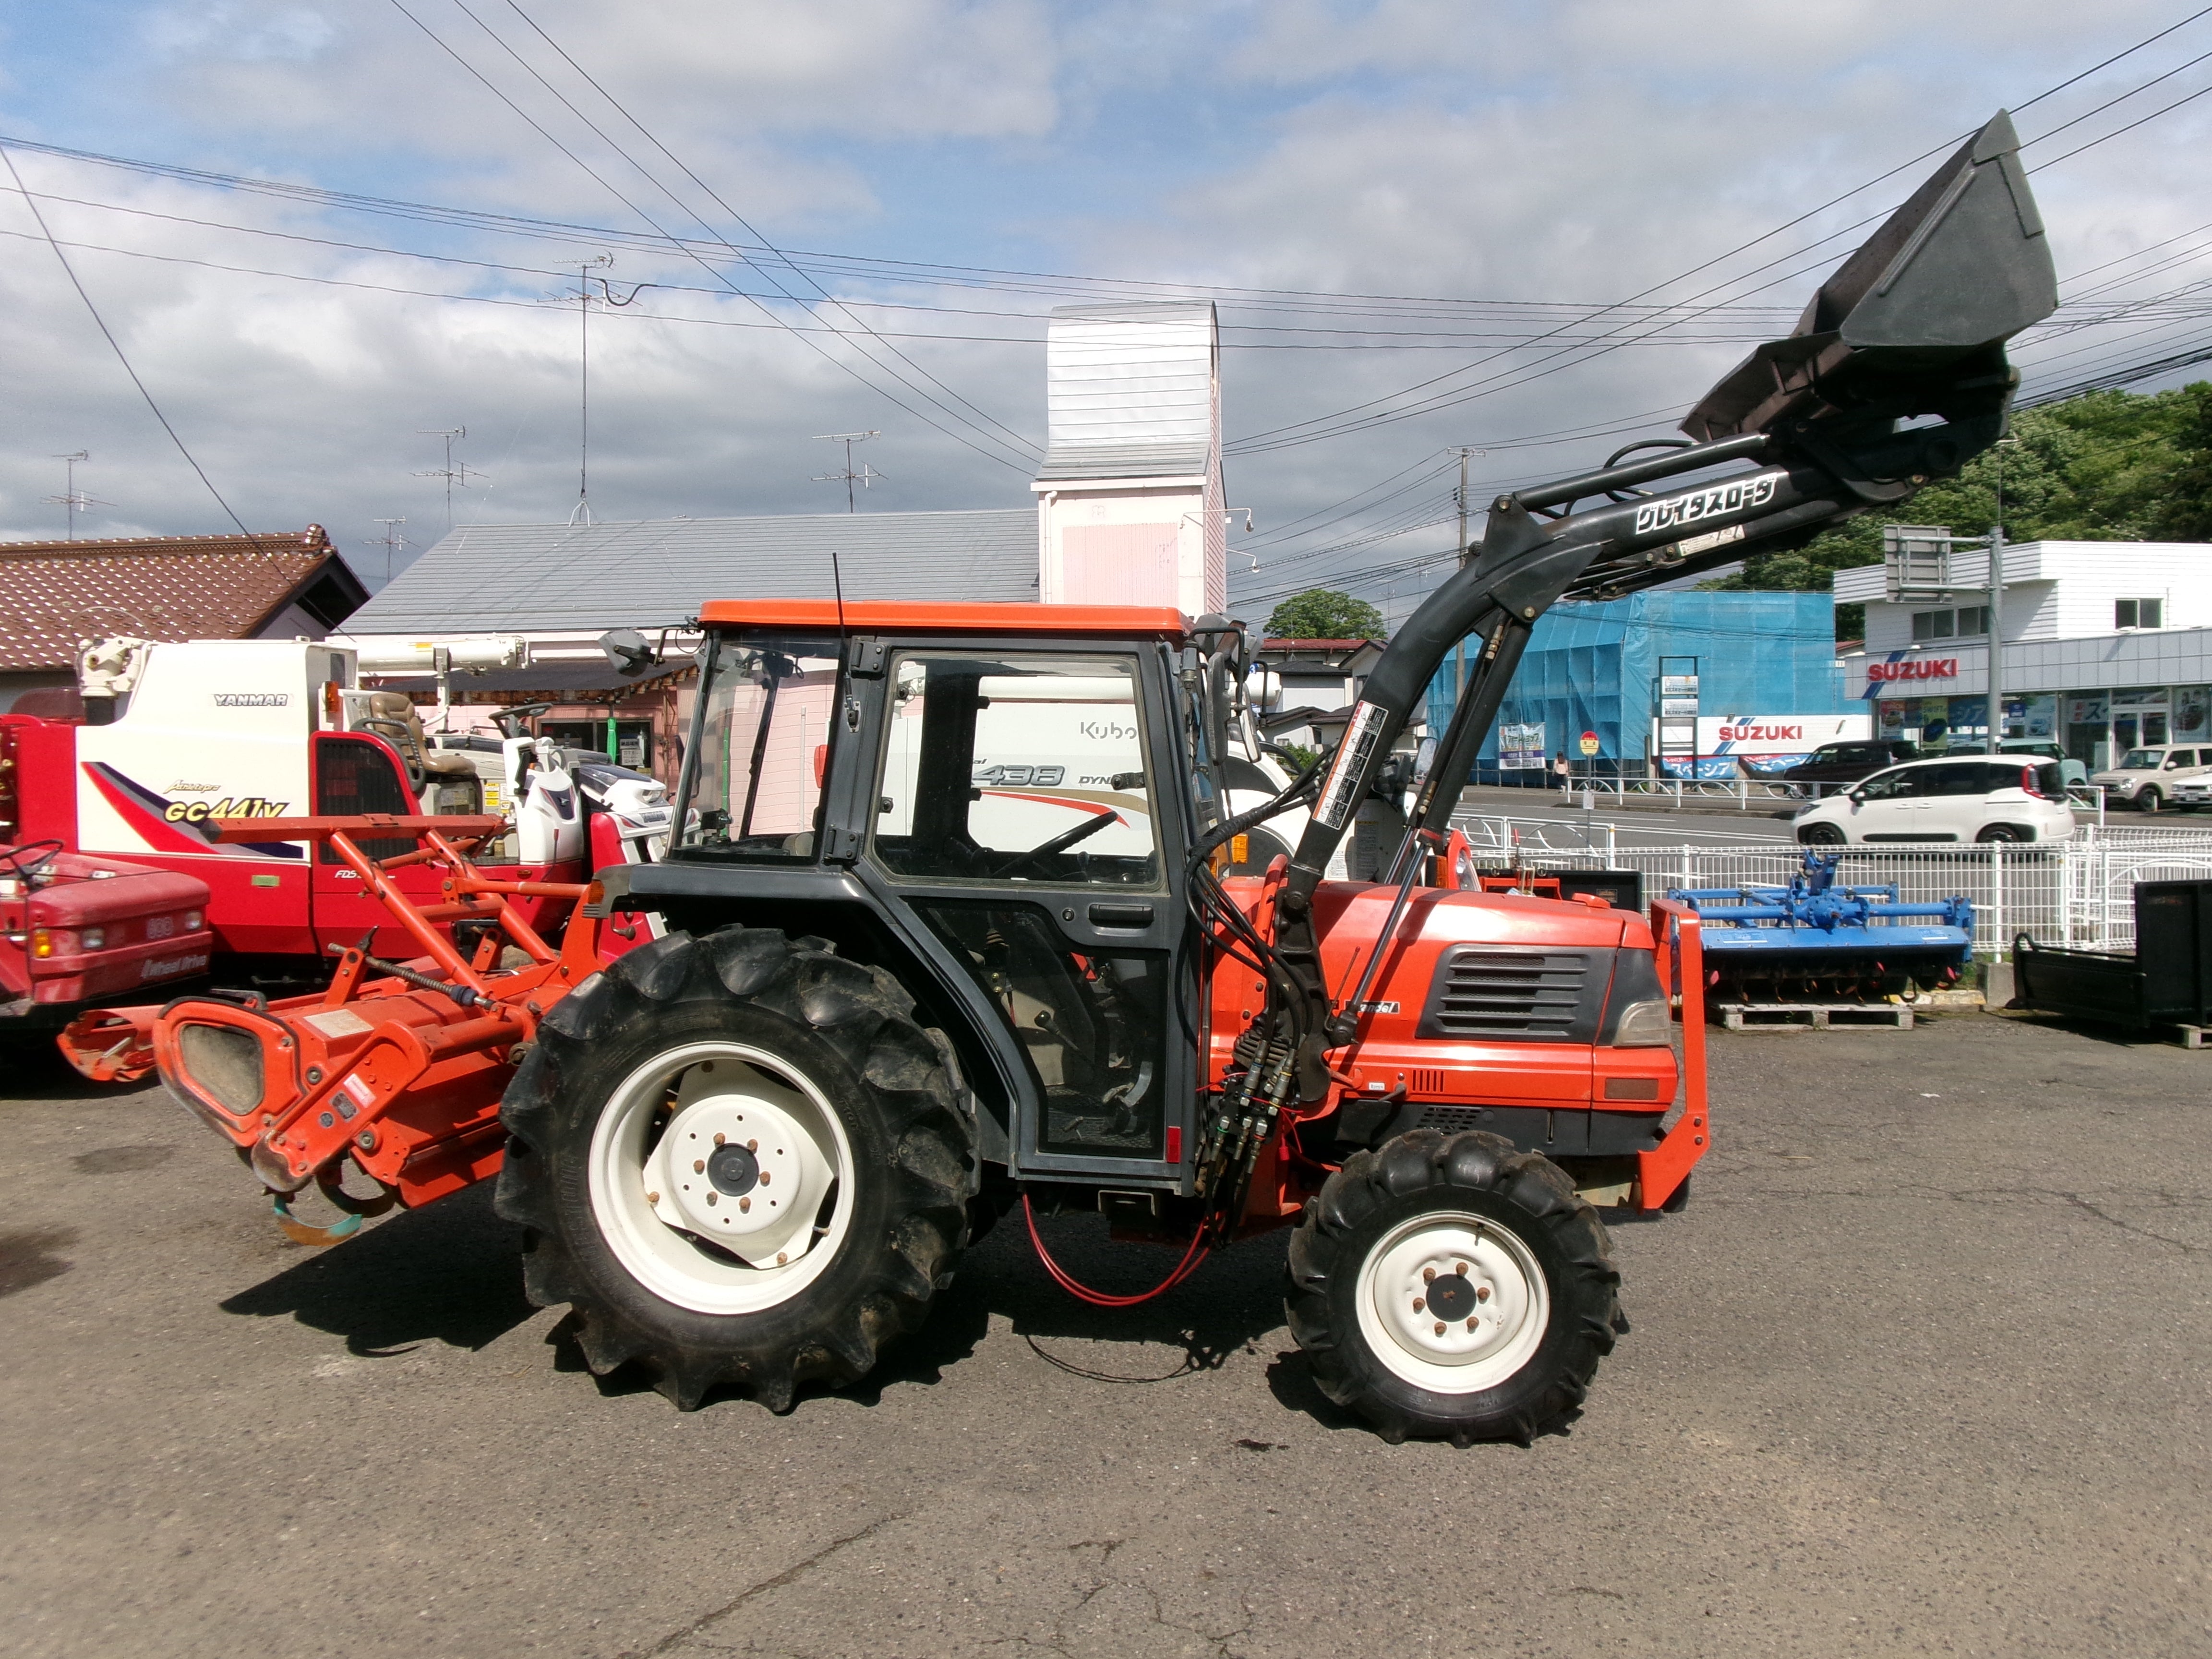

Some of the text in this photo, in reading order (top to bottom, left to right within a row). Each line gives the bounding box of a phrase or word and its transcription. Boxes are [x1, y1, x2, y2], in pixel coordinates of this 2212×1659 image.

[1869, 659, 1958, 681] SUZUKI
[214, 694, 288, 706] YANMAR
[1719, 726, 1803, 741] SUZUKI
[1078, 776, 1111, 784] DYN
